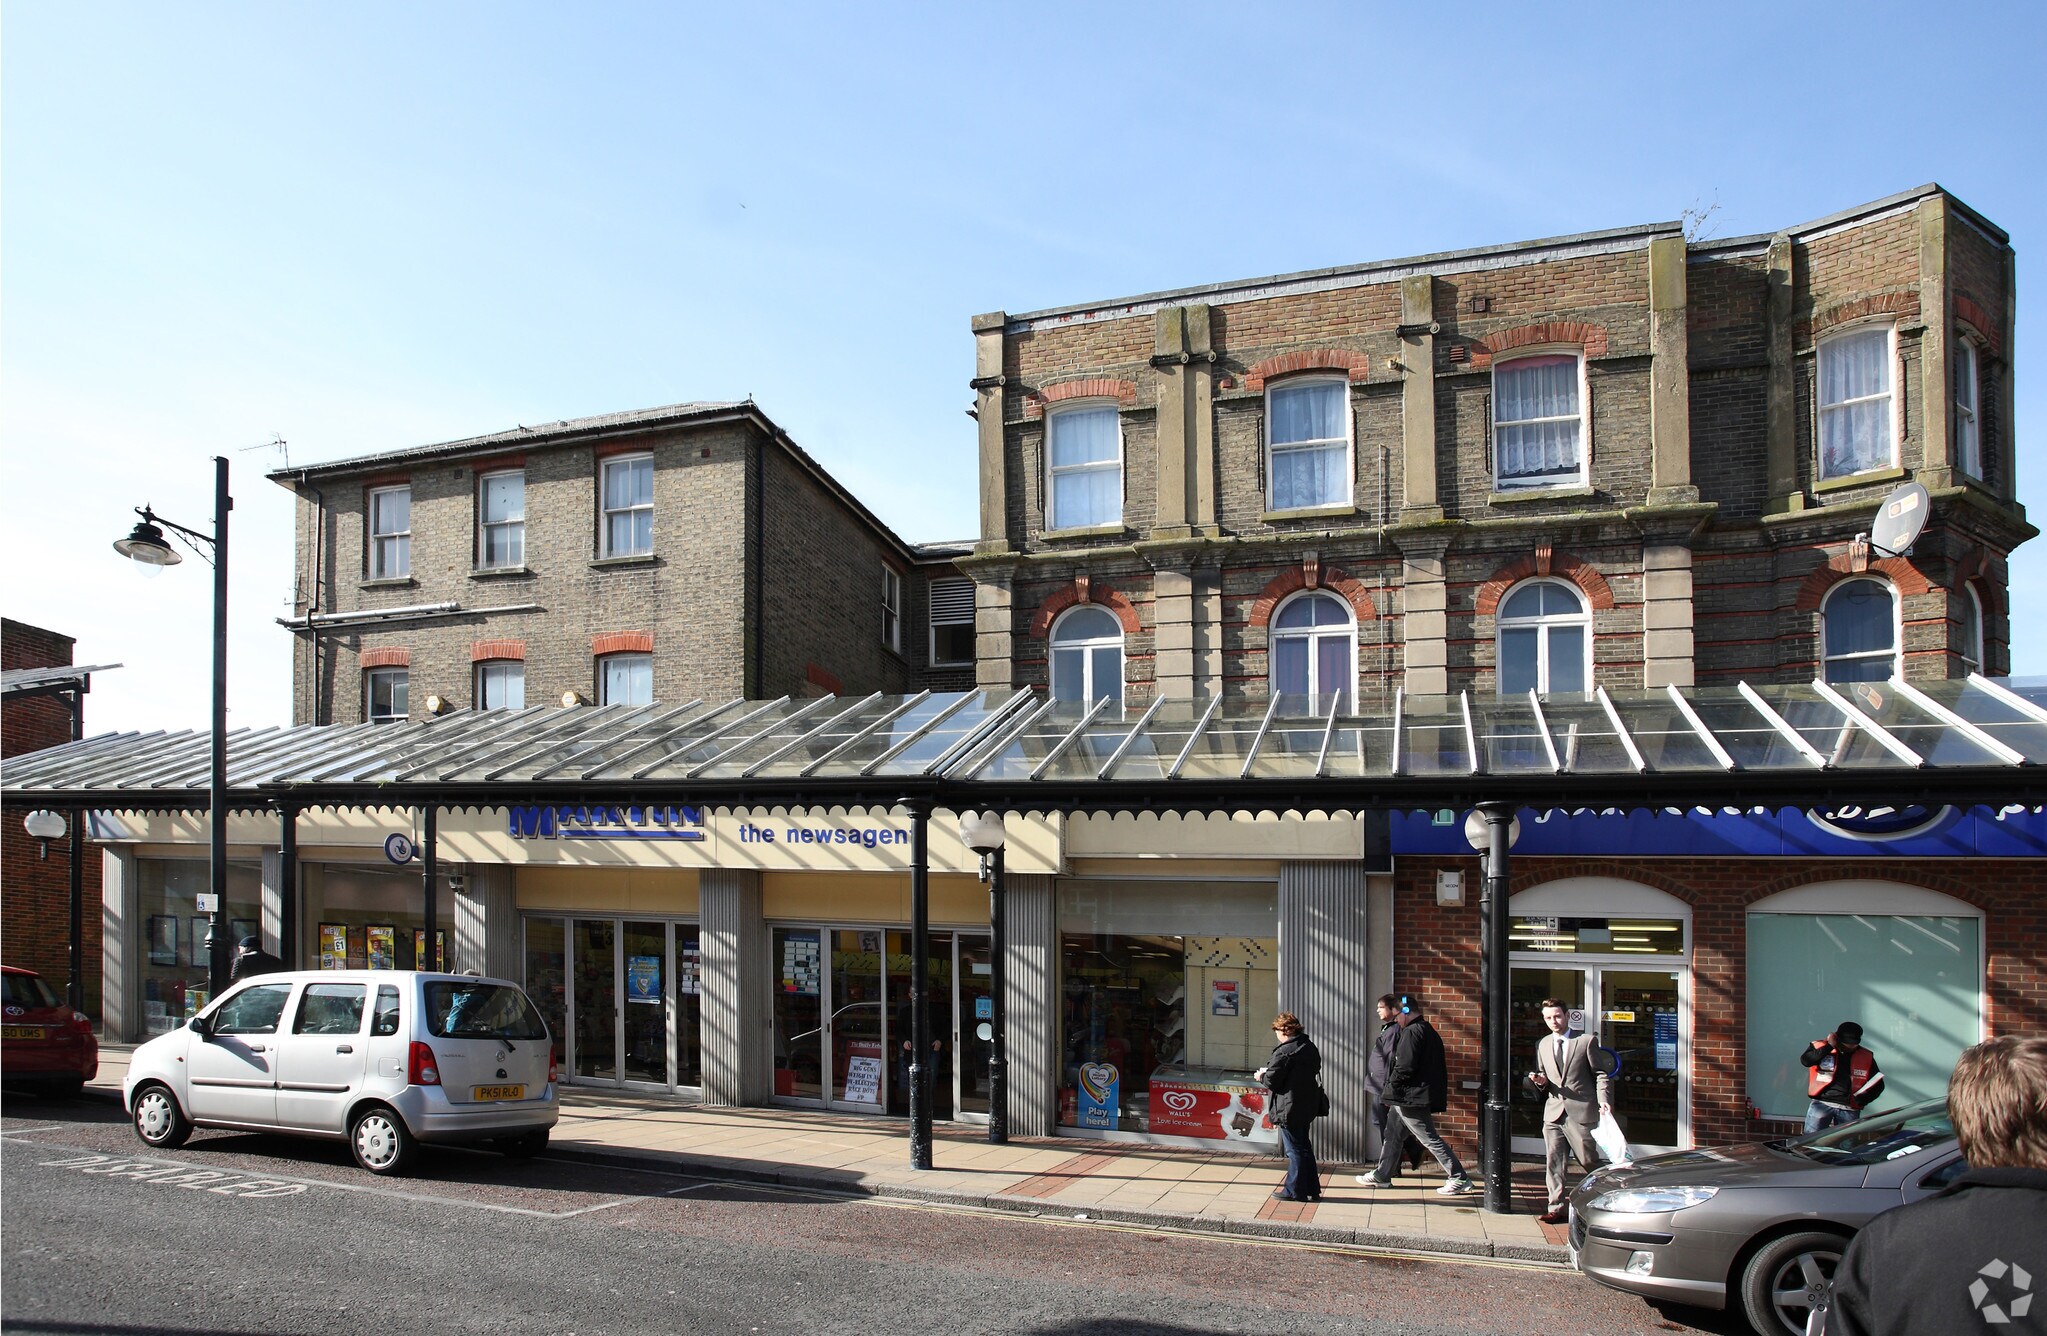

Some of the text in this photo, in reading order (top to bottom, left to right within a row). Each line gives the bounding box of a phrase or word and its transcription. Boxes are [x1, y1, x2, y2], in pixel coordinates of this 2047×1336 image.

[739, 824, 912, 848] the newsagen
[324, 928, 340, 936] NEW
[335, 941, 345, 950] £1
[862, 936, 880, 951] £1
[20, 1028, 40, 1037] UMS
[1088, 1107, 1108, 1117] Play
[1086, 1117, 1110, 1126] here!
[38, 1155, 308, 1198] DISABLED
